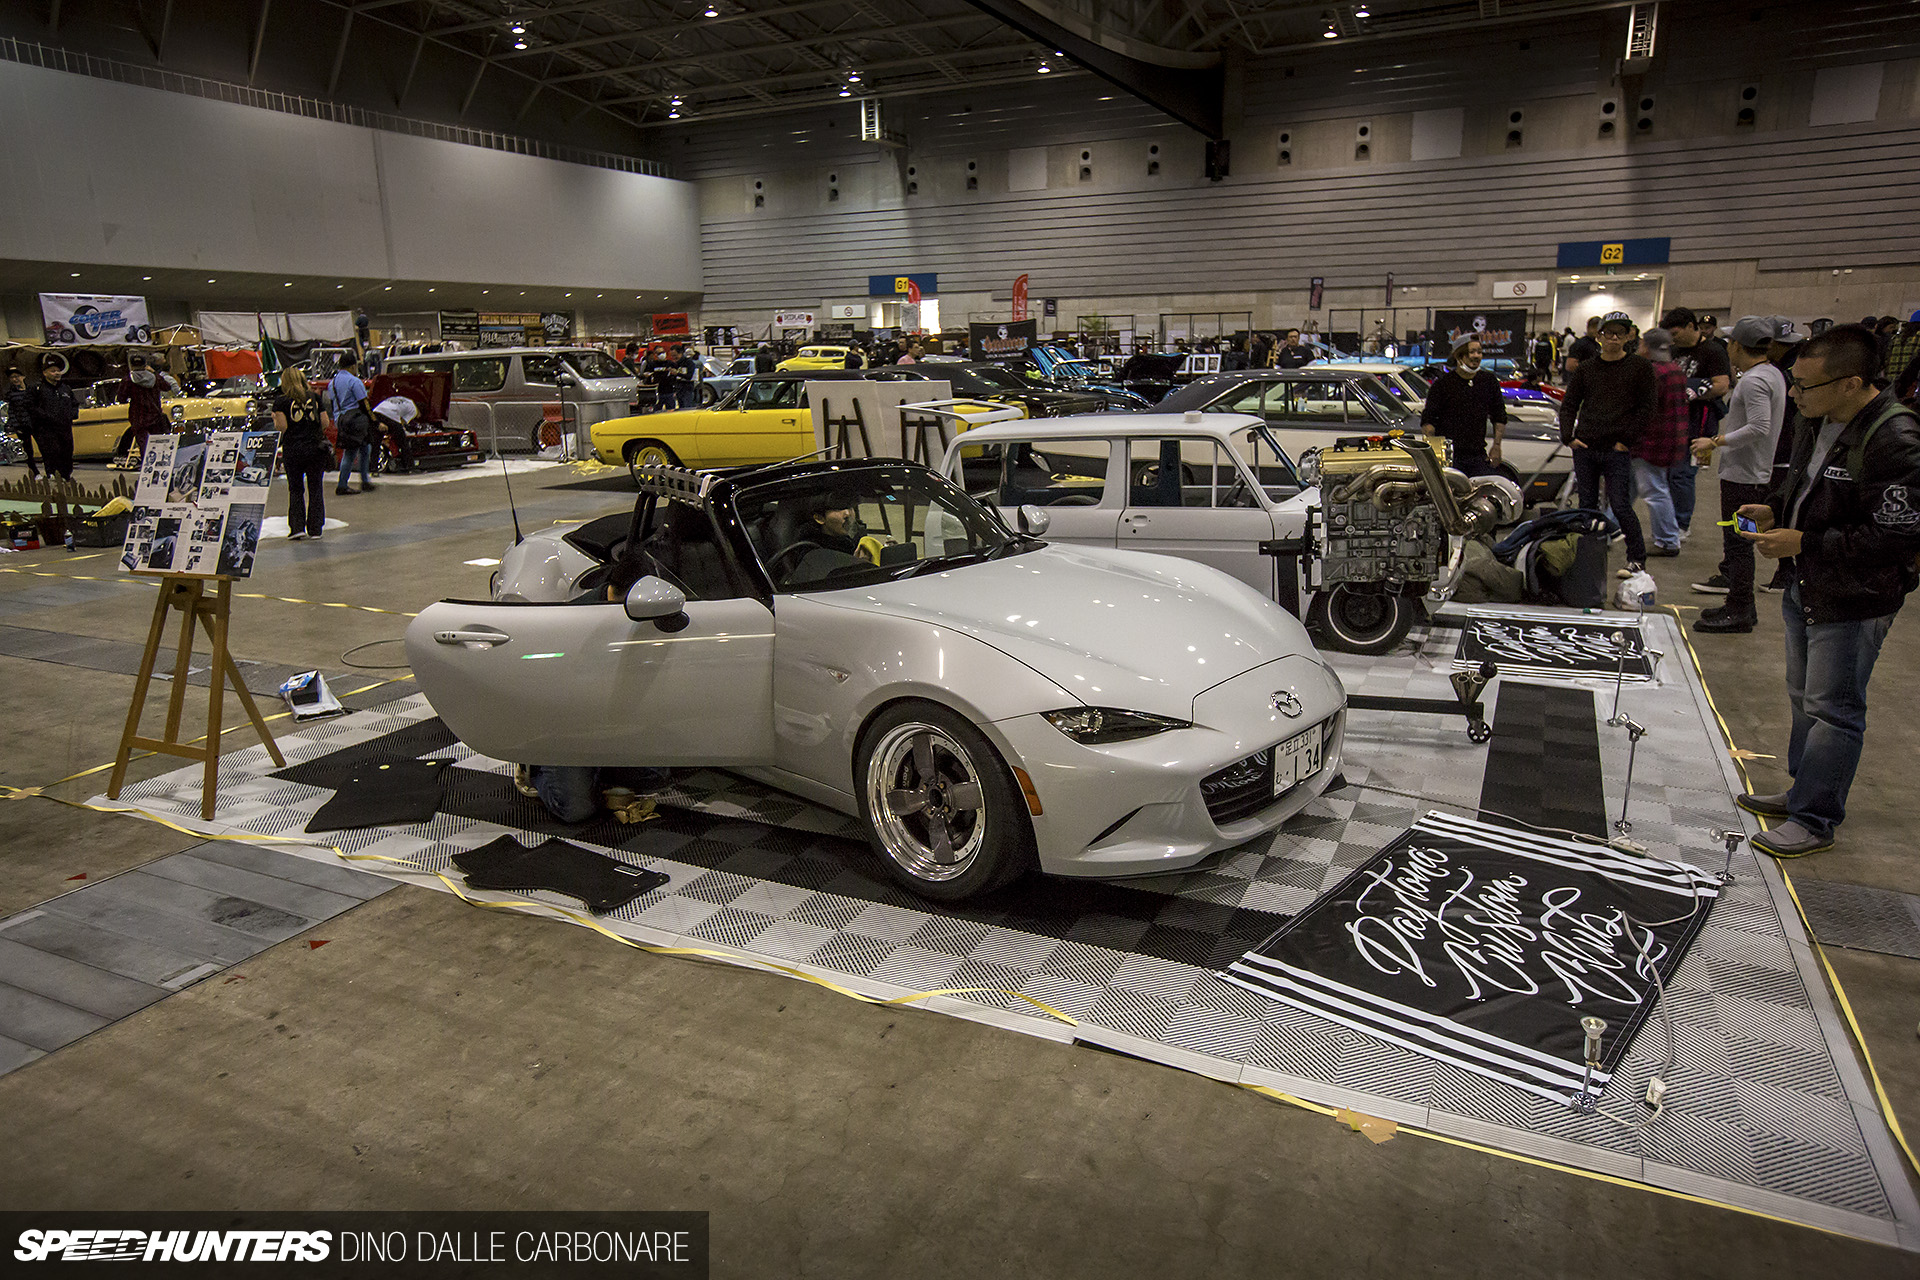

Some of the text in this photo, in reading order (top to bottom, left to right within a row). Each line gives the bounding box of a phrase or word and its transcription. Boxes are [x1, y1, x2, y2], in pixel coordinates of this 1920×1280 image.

[897, 280, 907, 290] G1
[1603, 247, 1621, 260] G2
[247, 437, 264, 449] DCC
[1345, 845, 1479, 988] Daytona
[1438, 866, 1538, 1001] Custom
[1541, 888, 1643, 1005] Club
